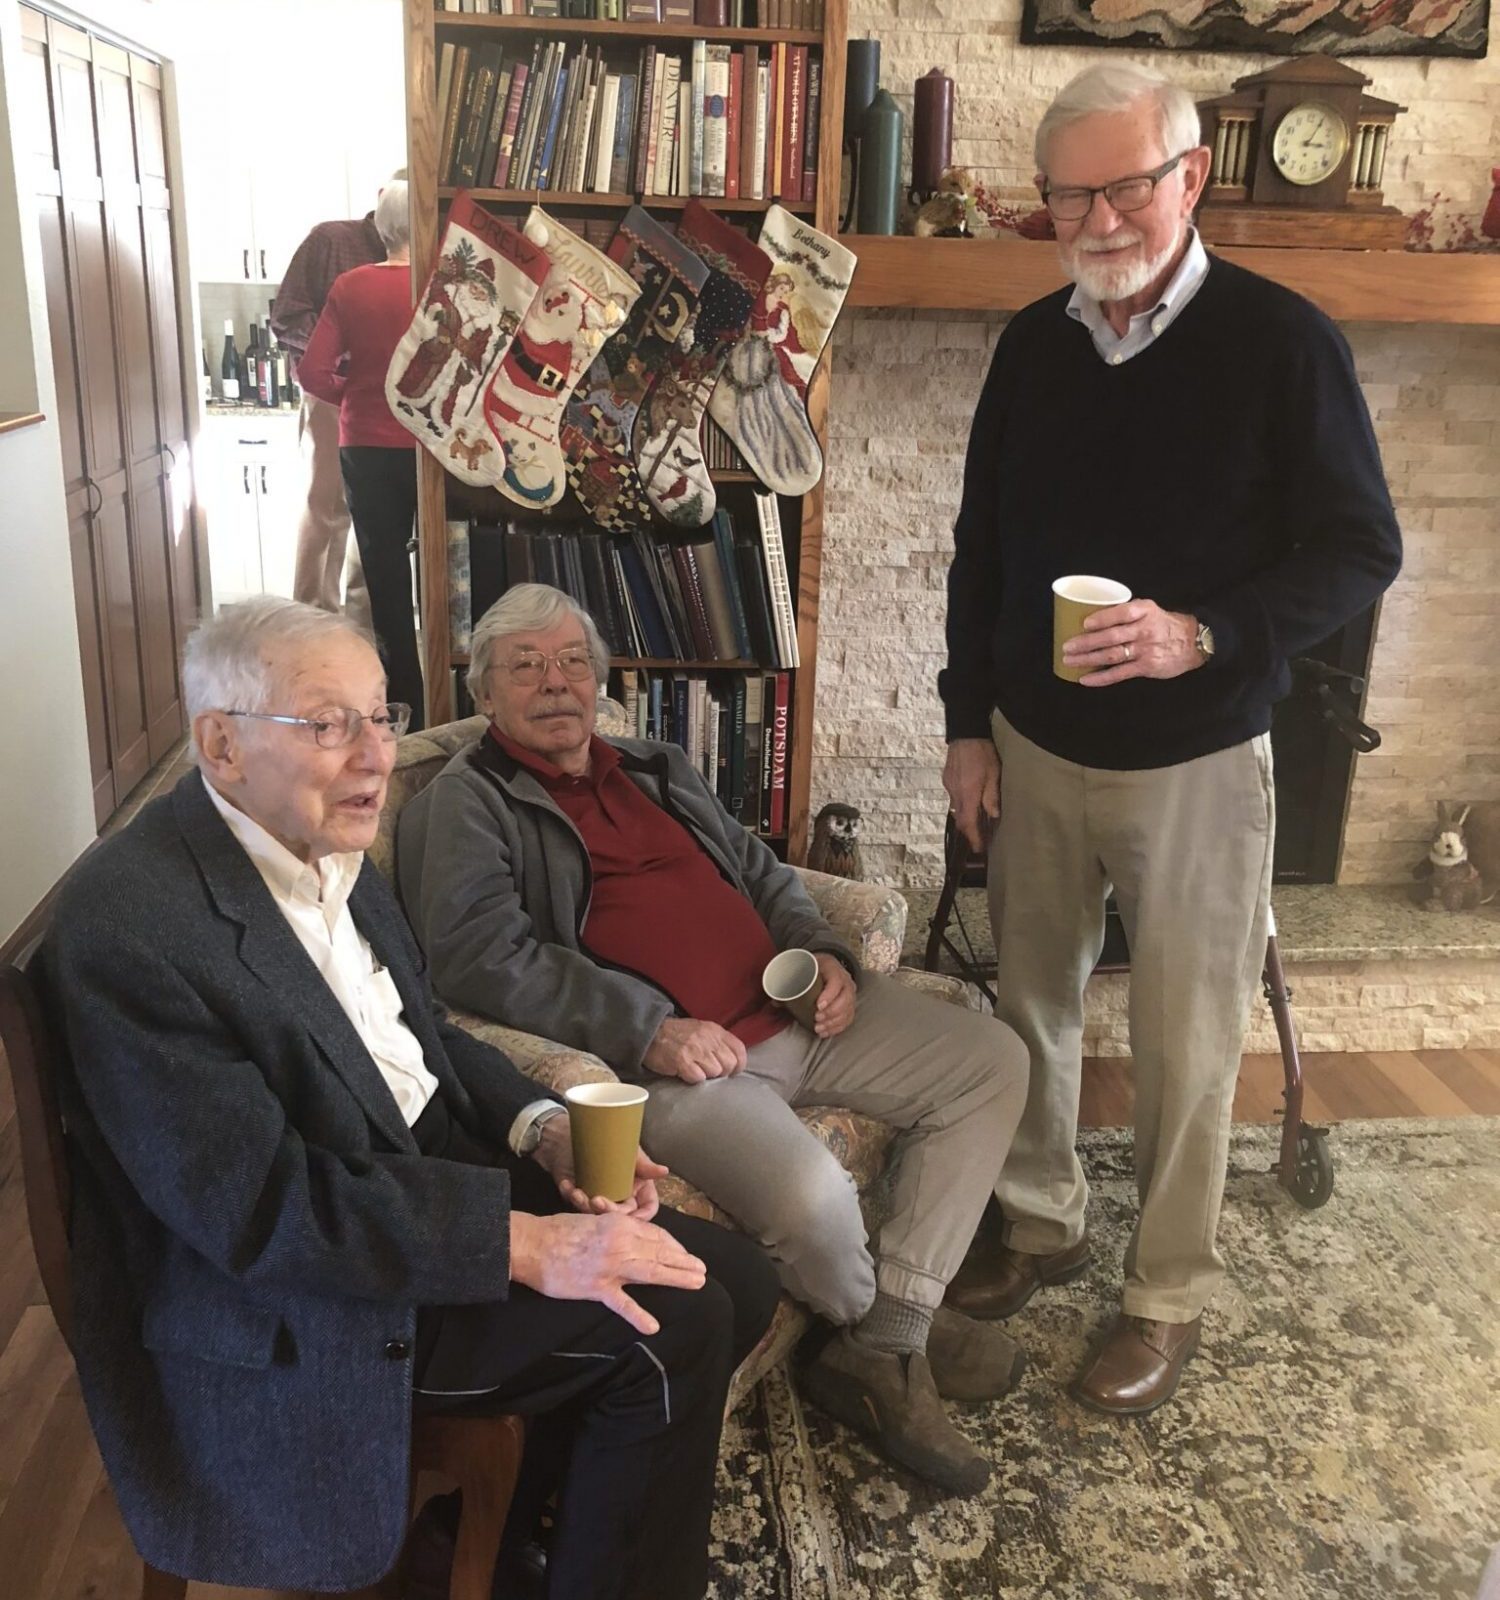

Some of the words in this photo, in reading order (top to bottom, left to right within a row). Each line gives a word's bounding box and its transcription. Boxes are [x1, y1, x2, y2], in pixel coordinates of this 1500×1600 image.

[790, 123, 799, 144] RISK
[471, 208, 537, 264] DREW
[792, 228, 831, 260] Bethany
[544, 230, 612, 300] Laurie
[764, 728, 772, 769] Deutschland
[772, 706, 788, 789] POTSDAM
[763, 770, 771, 790] heute
